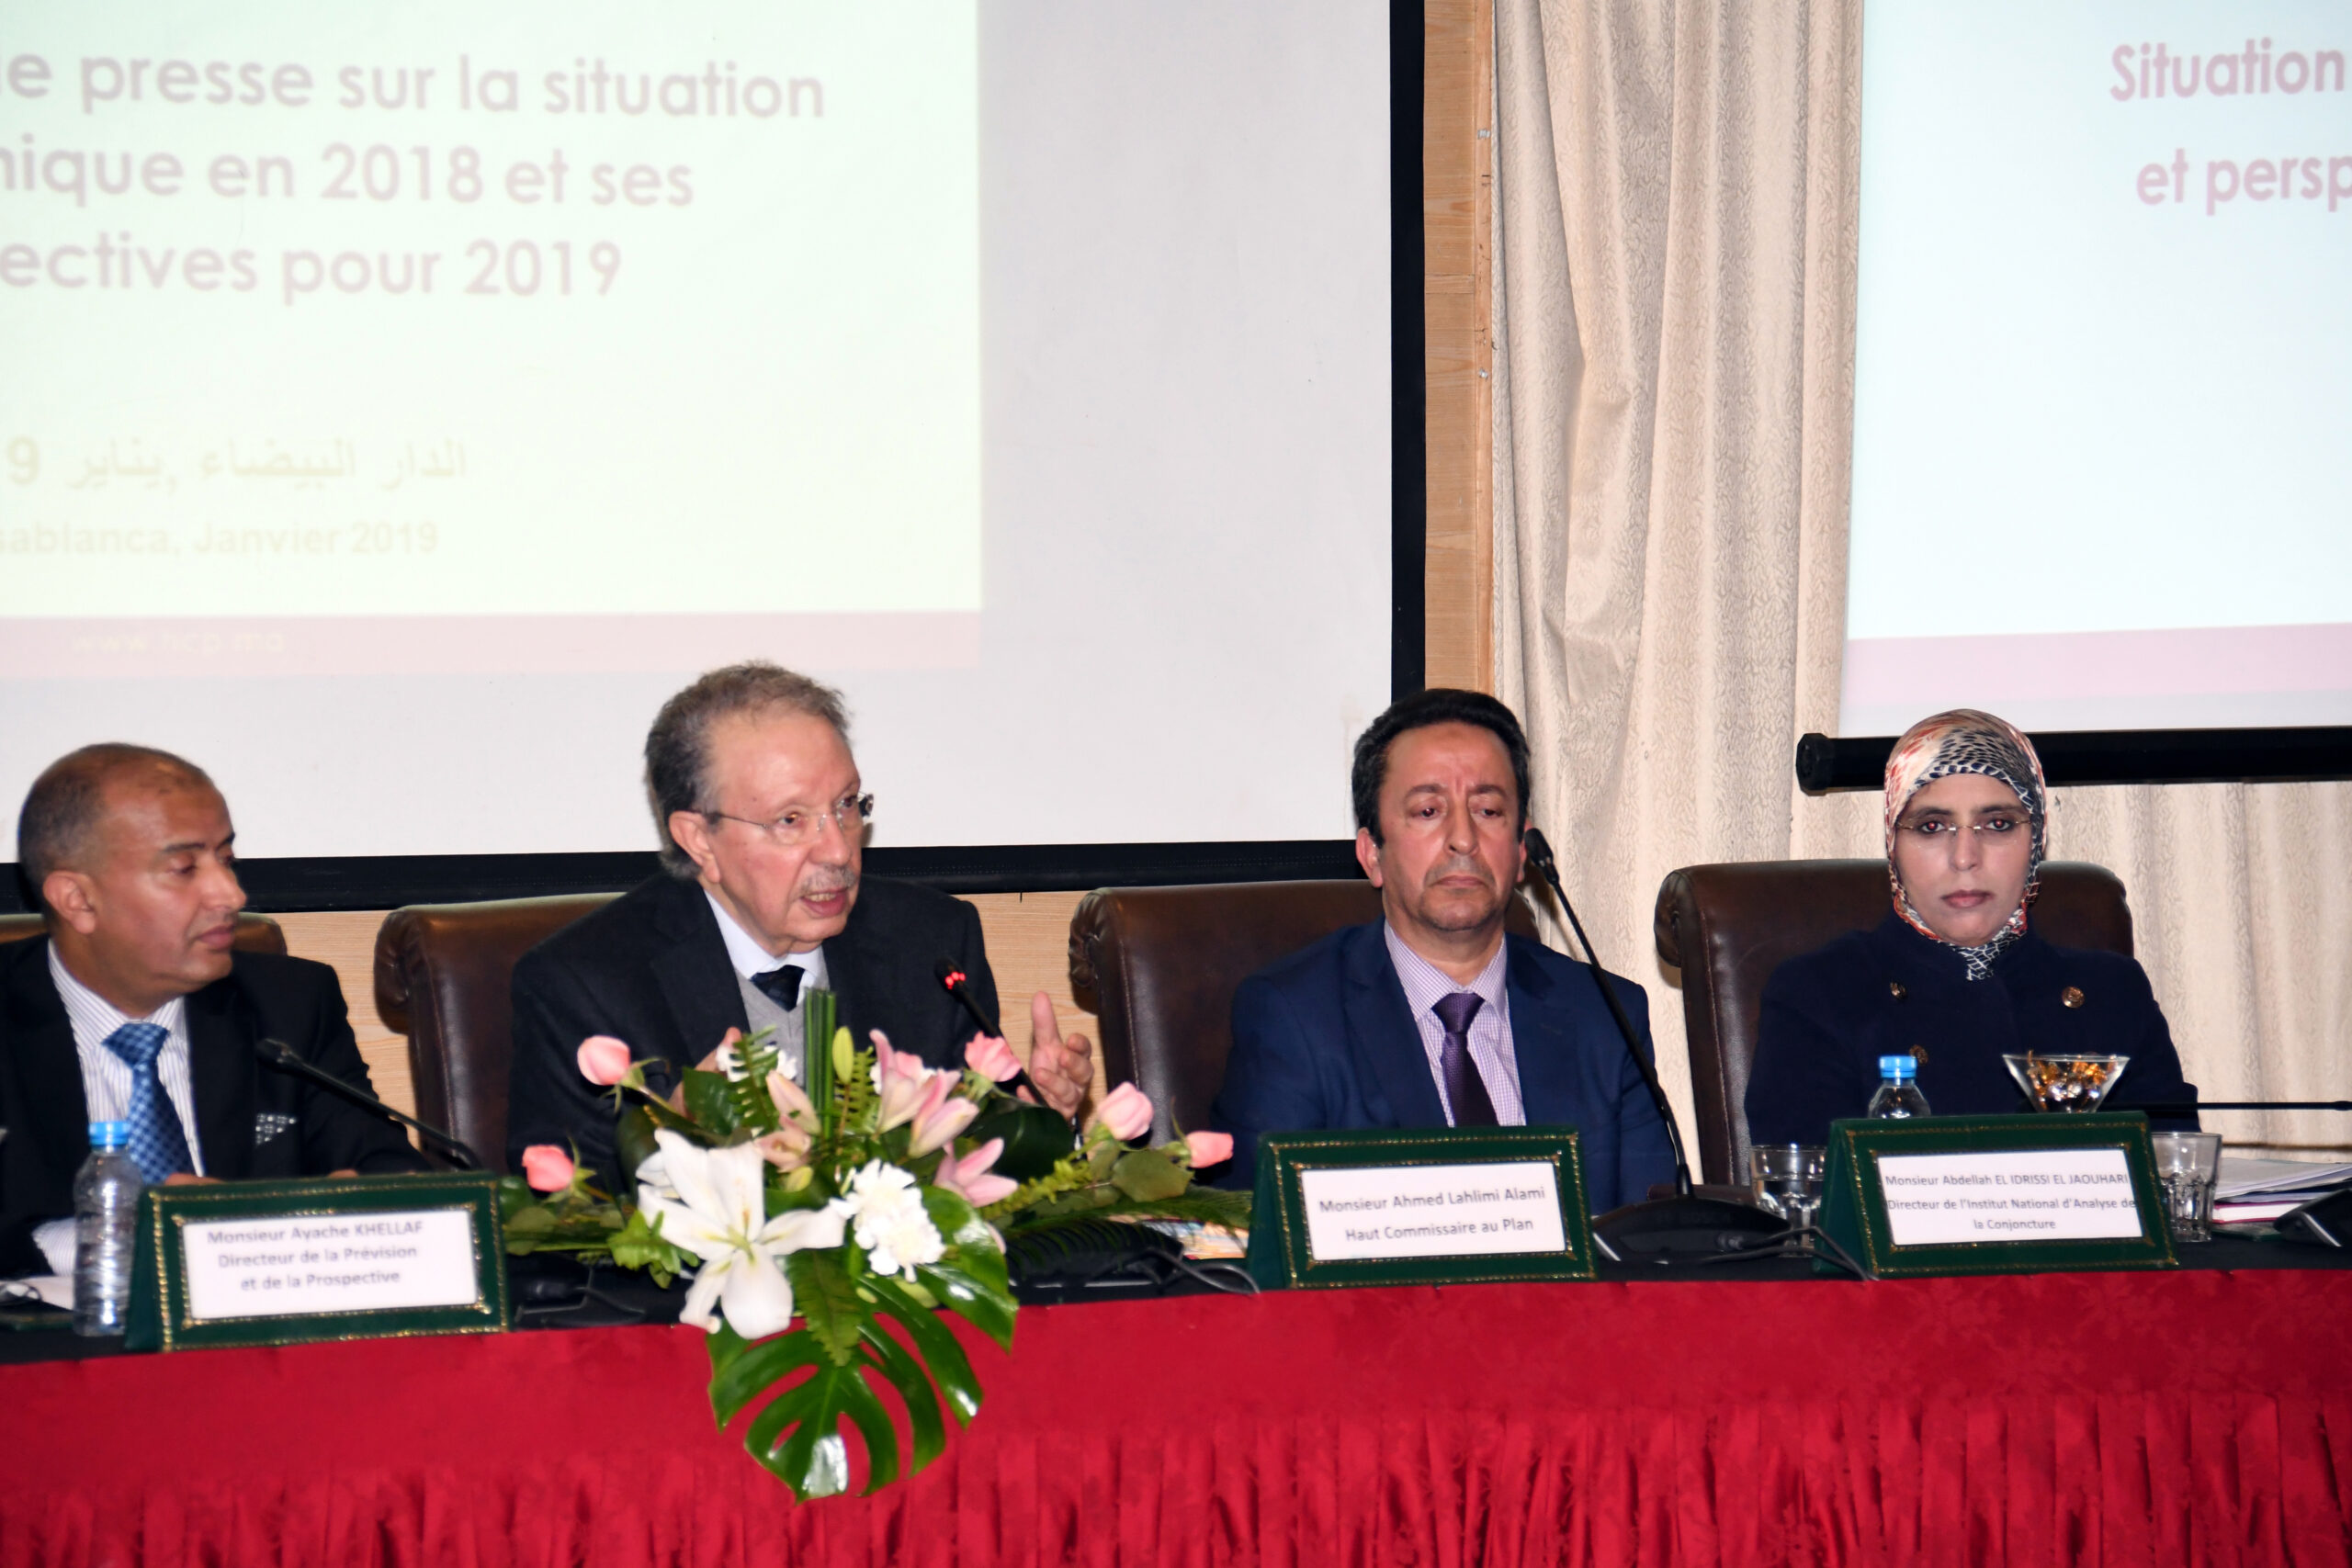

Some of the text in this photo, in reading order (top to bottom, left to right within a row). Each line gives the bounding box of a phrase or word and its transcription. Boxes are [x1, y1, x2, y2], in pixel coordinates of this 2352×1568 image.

[2110, 35, 2346, 102] Situation
[78, 55, 314, 117] presse
[337, 64, 436, 111] sur
[458, 52, 520, 113] la
[543, 56, 825, 119] situation
[207, 153, 295, 198] en
[320, 141, 485, 204] 2018
[503, 147, 571, 205] et
[591, 162, 695, 208] ses
[2135, 147, 2352, 217] et persp
[0, 230, 622, 308] ectives pour 2019
[0, 518, 439, 558] ablanca, Janvier 2019
[1883, 1171, 2131, 1187] Monsieur Abdellah EL IDRISSI EL JAOUHARI
[1317, 1187, 1545, 1213] Monsieur Ahmed Lahlimi Alami
[1886, 1199, 1940, 1212] Directeur
[1942, 1199, 1958, 1211] de
[2009, 1198, 2061, 1210] National
[207, 1220, 423, 1245] Monsieur Ayache KHELLAF
[1345, 1217, 1534, 1242] Haut Commissaire au Plan
[1973, 1218, 2056, 1232] la Conjoncture
[218, 1253, 296, 1269] Directeur
[300, 1249, 321, 1263] de
[324, 1248, 340, 1262] la
[240, 1269, 401, 1291] et de la Prospective
